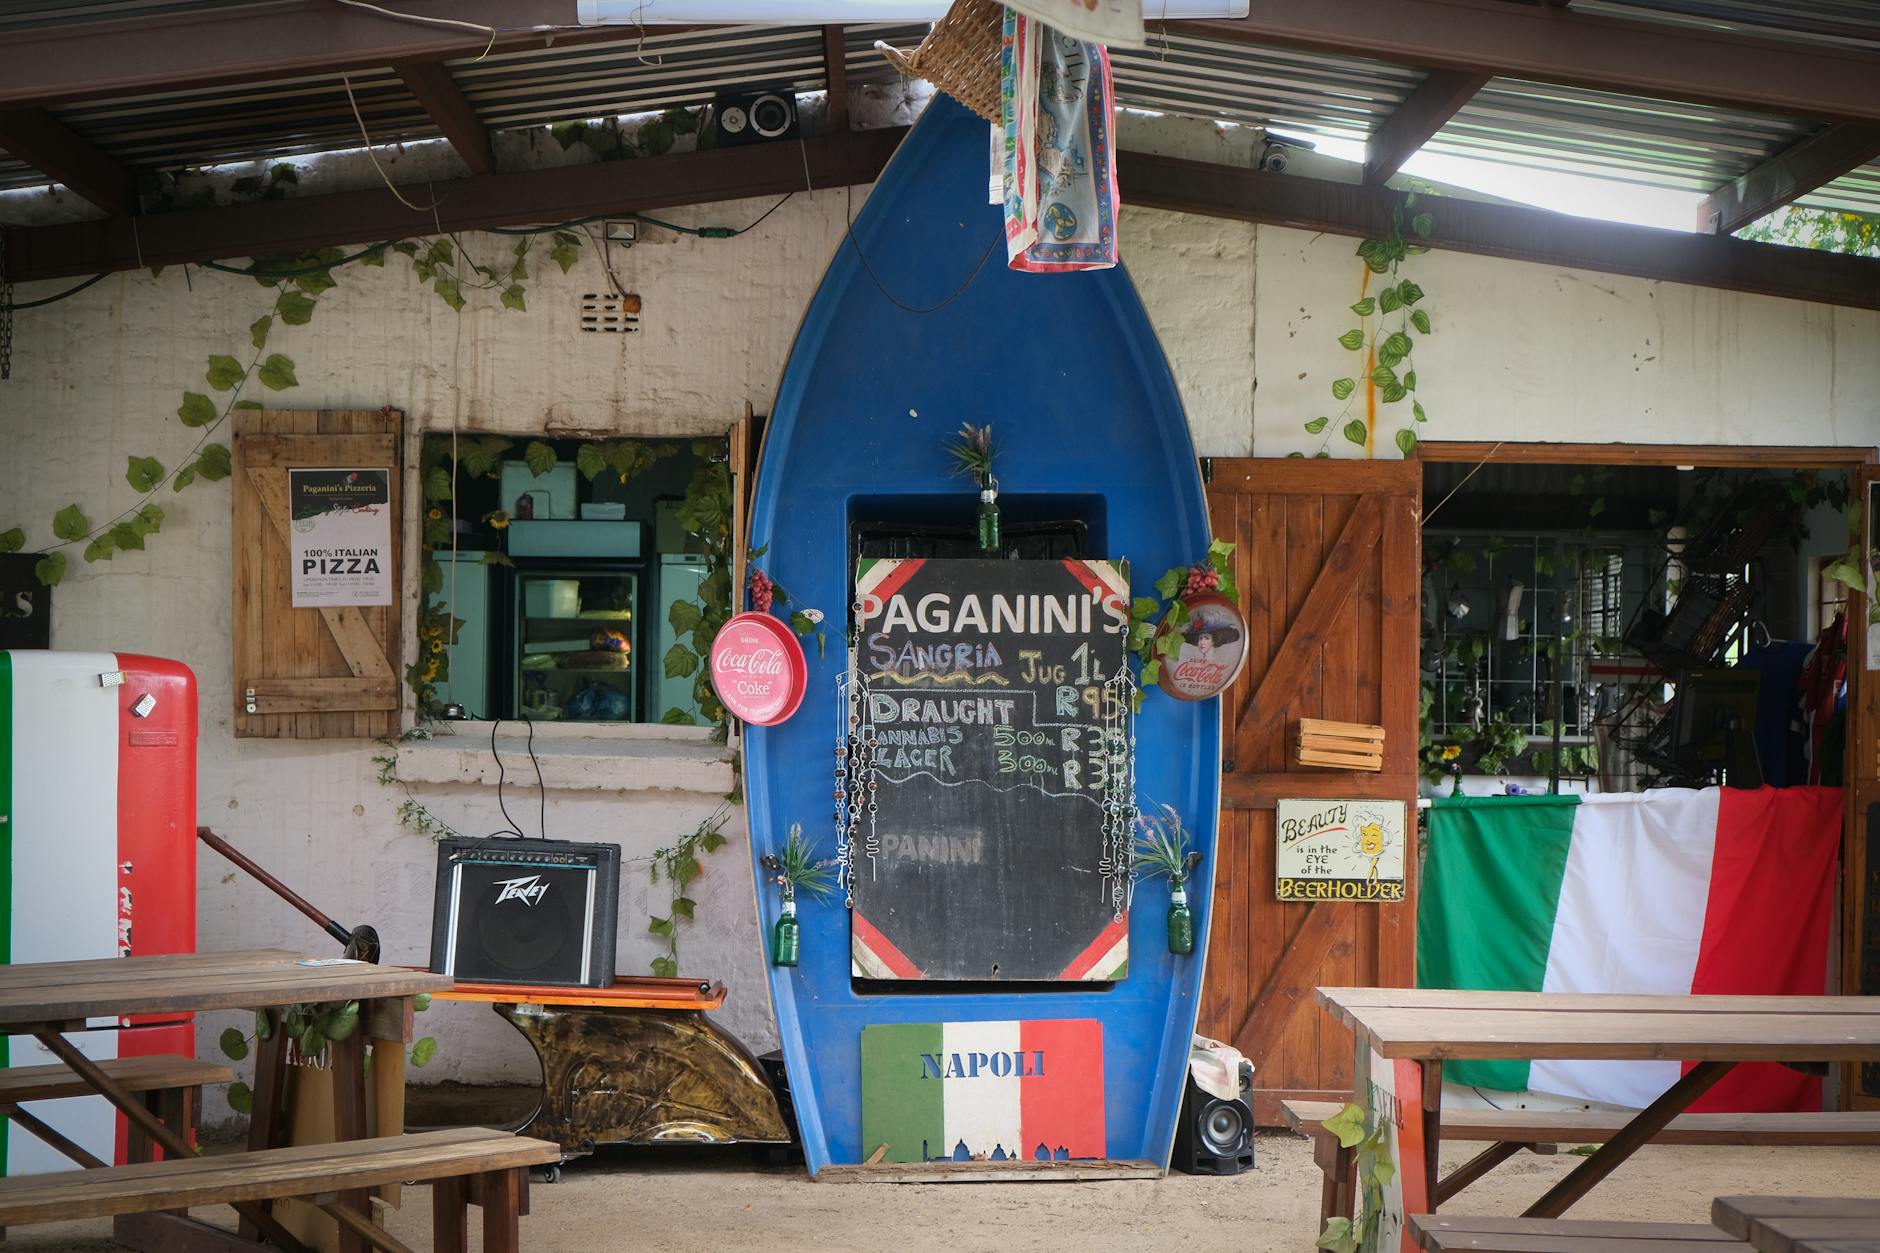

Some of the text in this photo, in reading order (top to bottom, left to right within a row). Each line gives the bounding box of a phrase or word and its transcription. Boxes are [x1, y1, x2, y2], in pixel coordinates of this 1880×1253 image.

[303, 484, 376, 495] Paganini's Pizzeria
[303, 559, 380, 574] PIZZA
[857, 586, 1127, 634] PAGANINI'S
[733, 680, 772, 695] "Coke"
[870, 693, 1014, 724] DRAUGHT
[857, 725, 963, 746] CANNABIS
[1281, 803, 1348, 843] BEAUTY
[1308, 845, 1317, 853] in
[1320, 845, 1338, 853] the
[1306, 855, 1328, 864] EYE
[1301, 866, 1333, 874] of the
[493, 875, 550, 907] PEAVEY
[1280, 879, 1400, 898] BEERHOLDER
[920, 1051, 1045, 1079] NAPOLI
